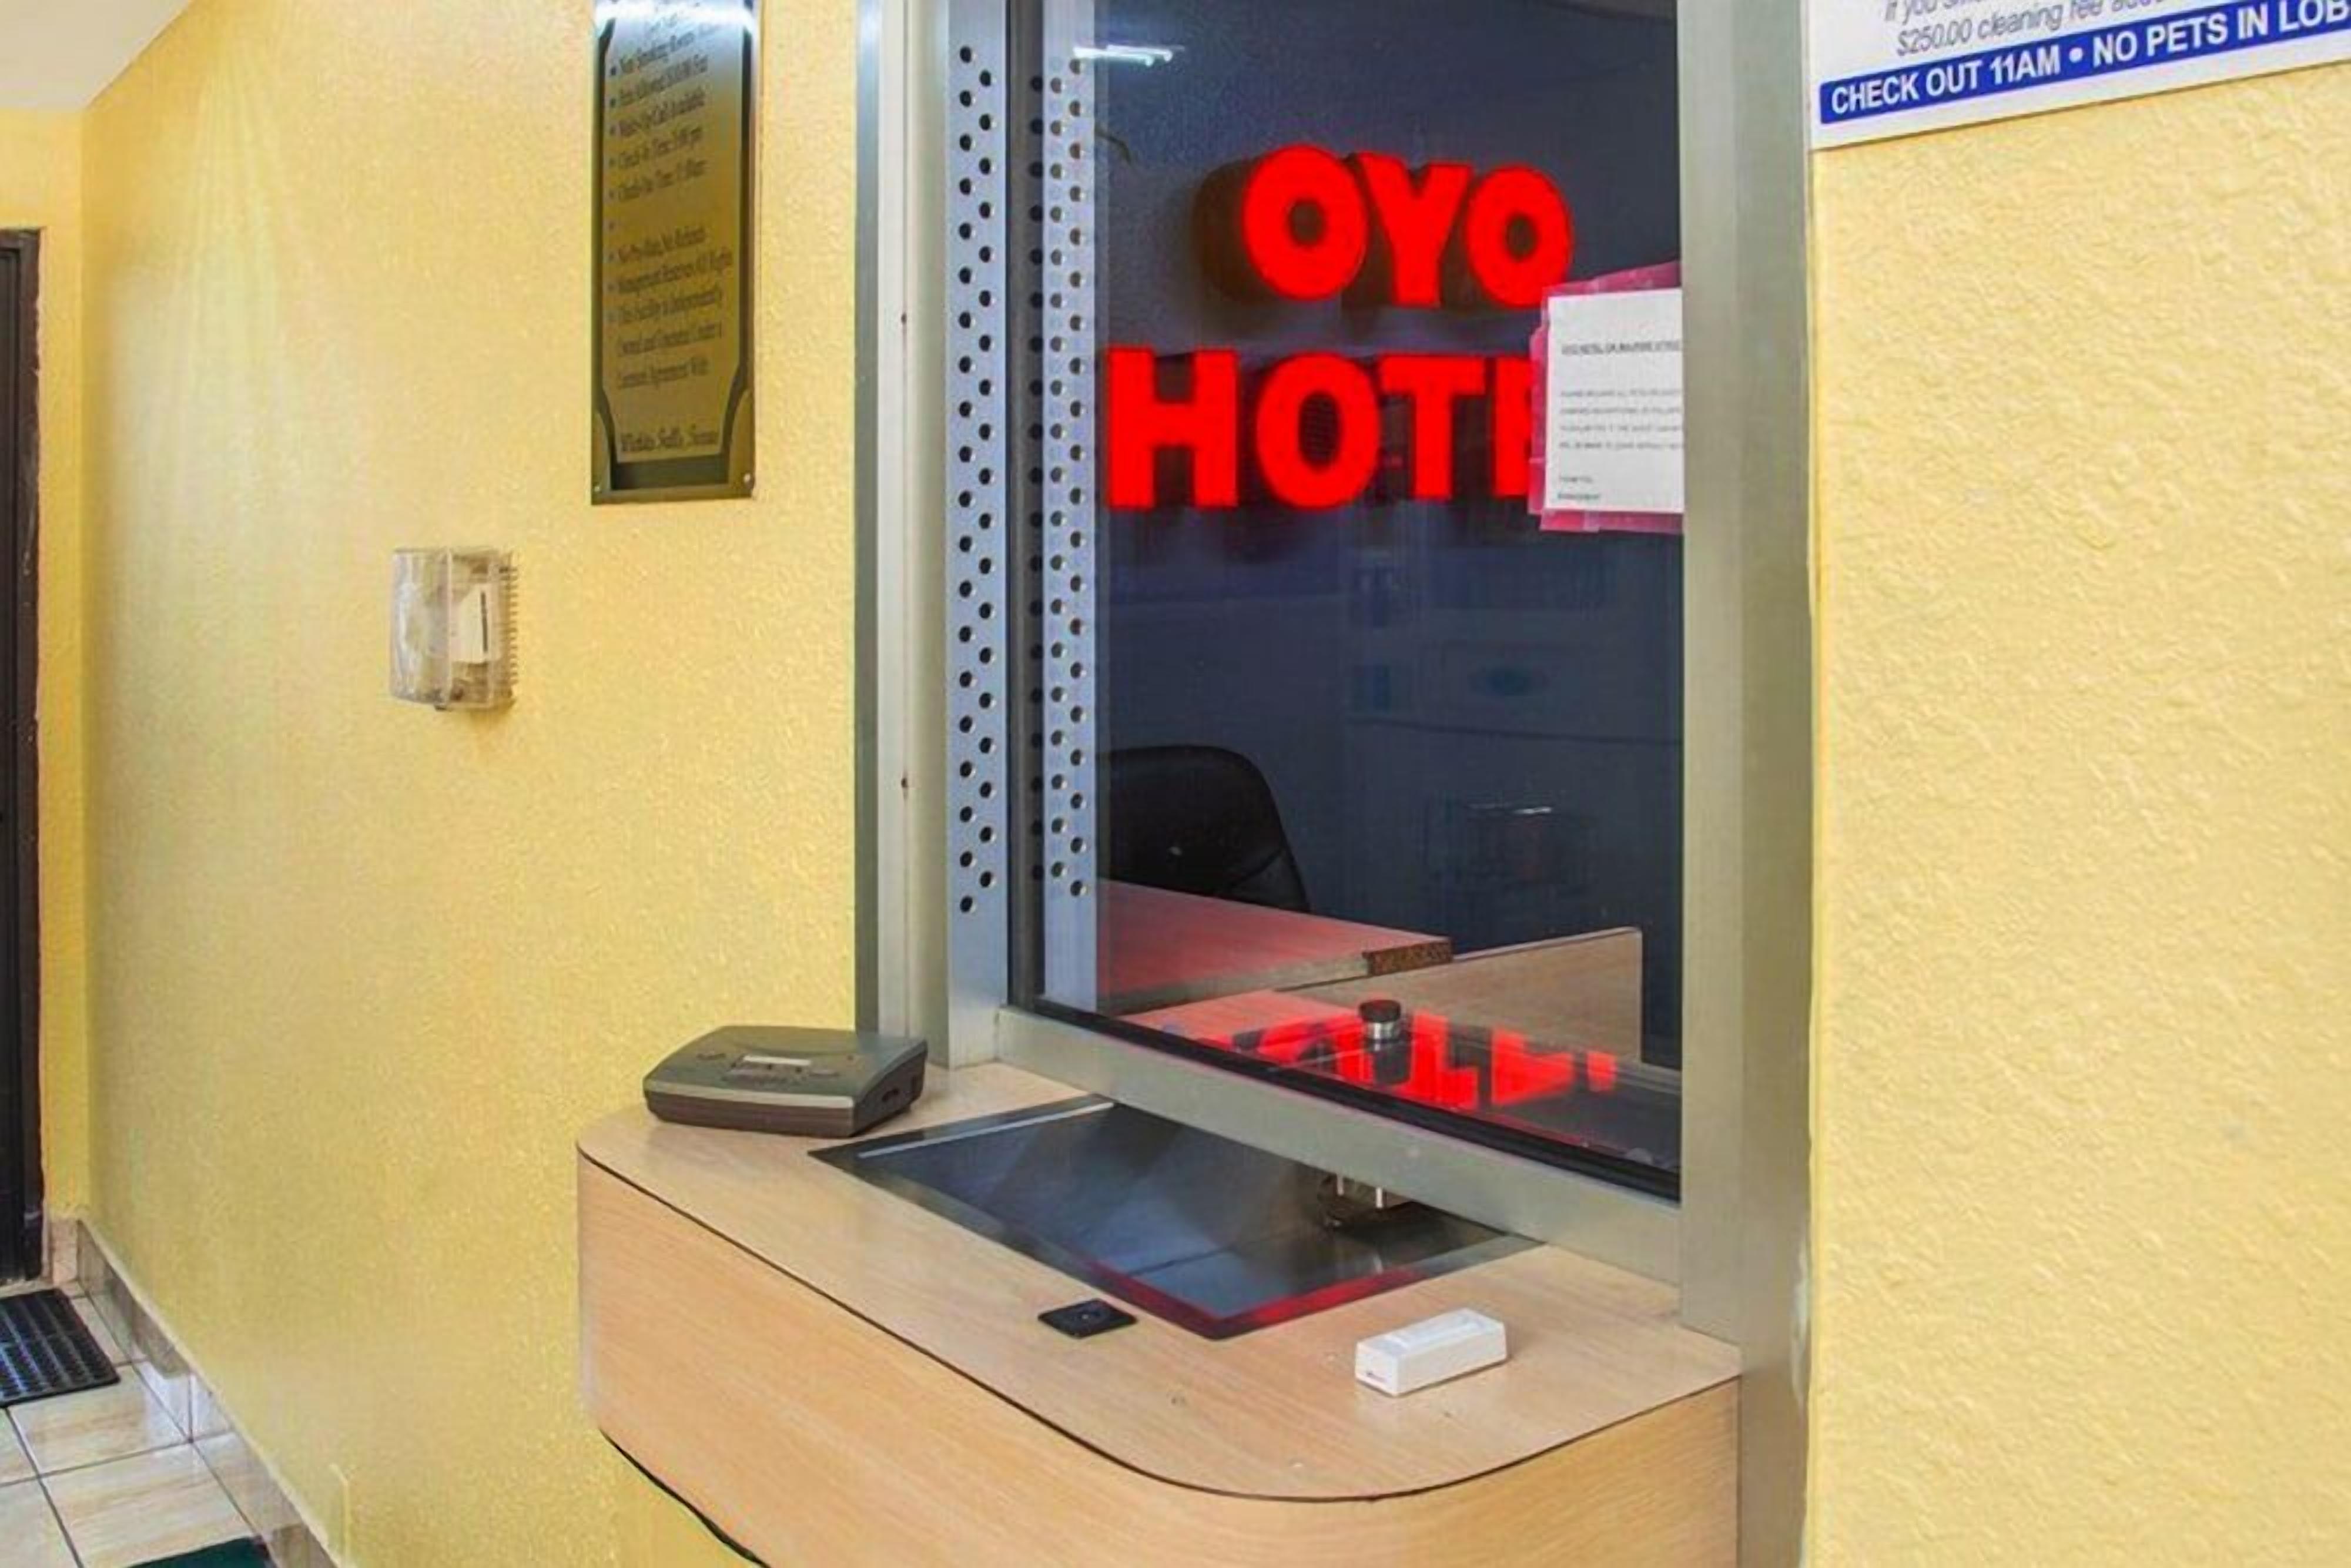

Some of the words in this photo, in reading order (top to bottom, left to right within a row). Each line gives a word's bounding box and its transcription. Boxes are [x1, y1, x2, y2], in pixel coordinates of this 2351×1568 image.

[1831, 72, 1919, 114] CHECK
[1926, 60, 1982, 95] OUT
[1990, 44, 2061, 85] 11AM
[2093, 31, 2138, 68] NO
[2147, 12, 2228, 57] PETS
[2238, 5, 2269, 40] IN
[1977, 5, 2062, 39] cleaning
[1242, 145, 1570, 309] OYO
